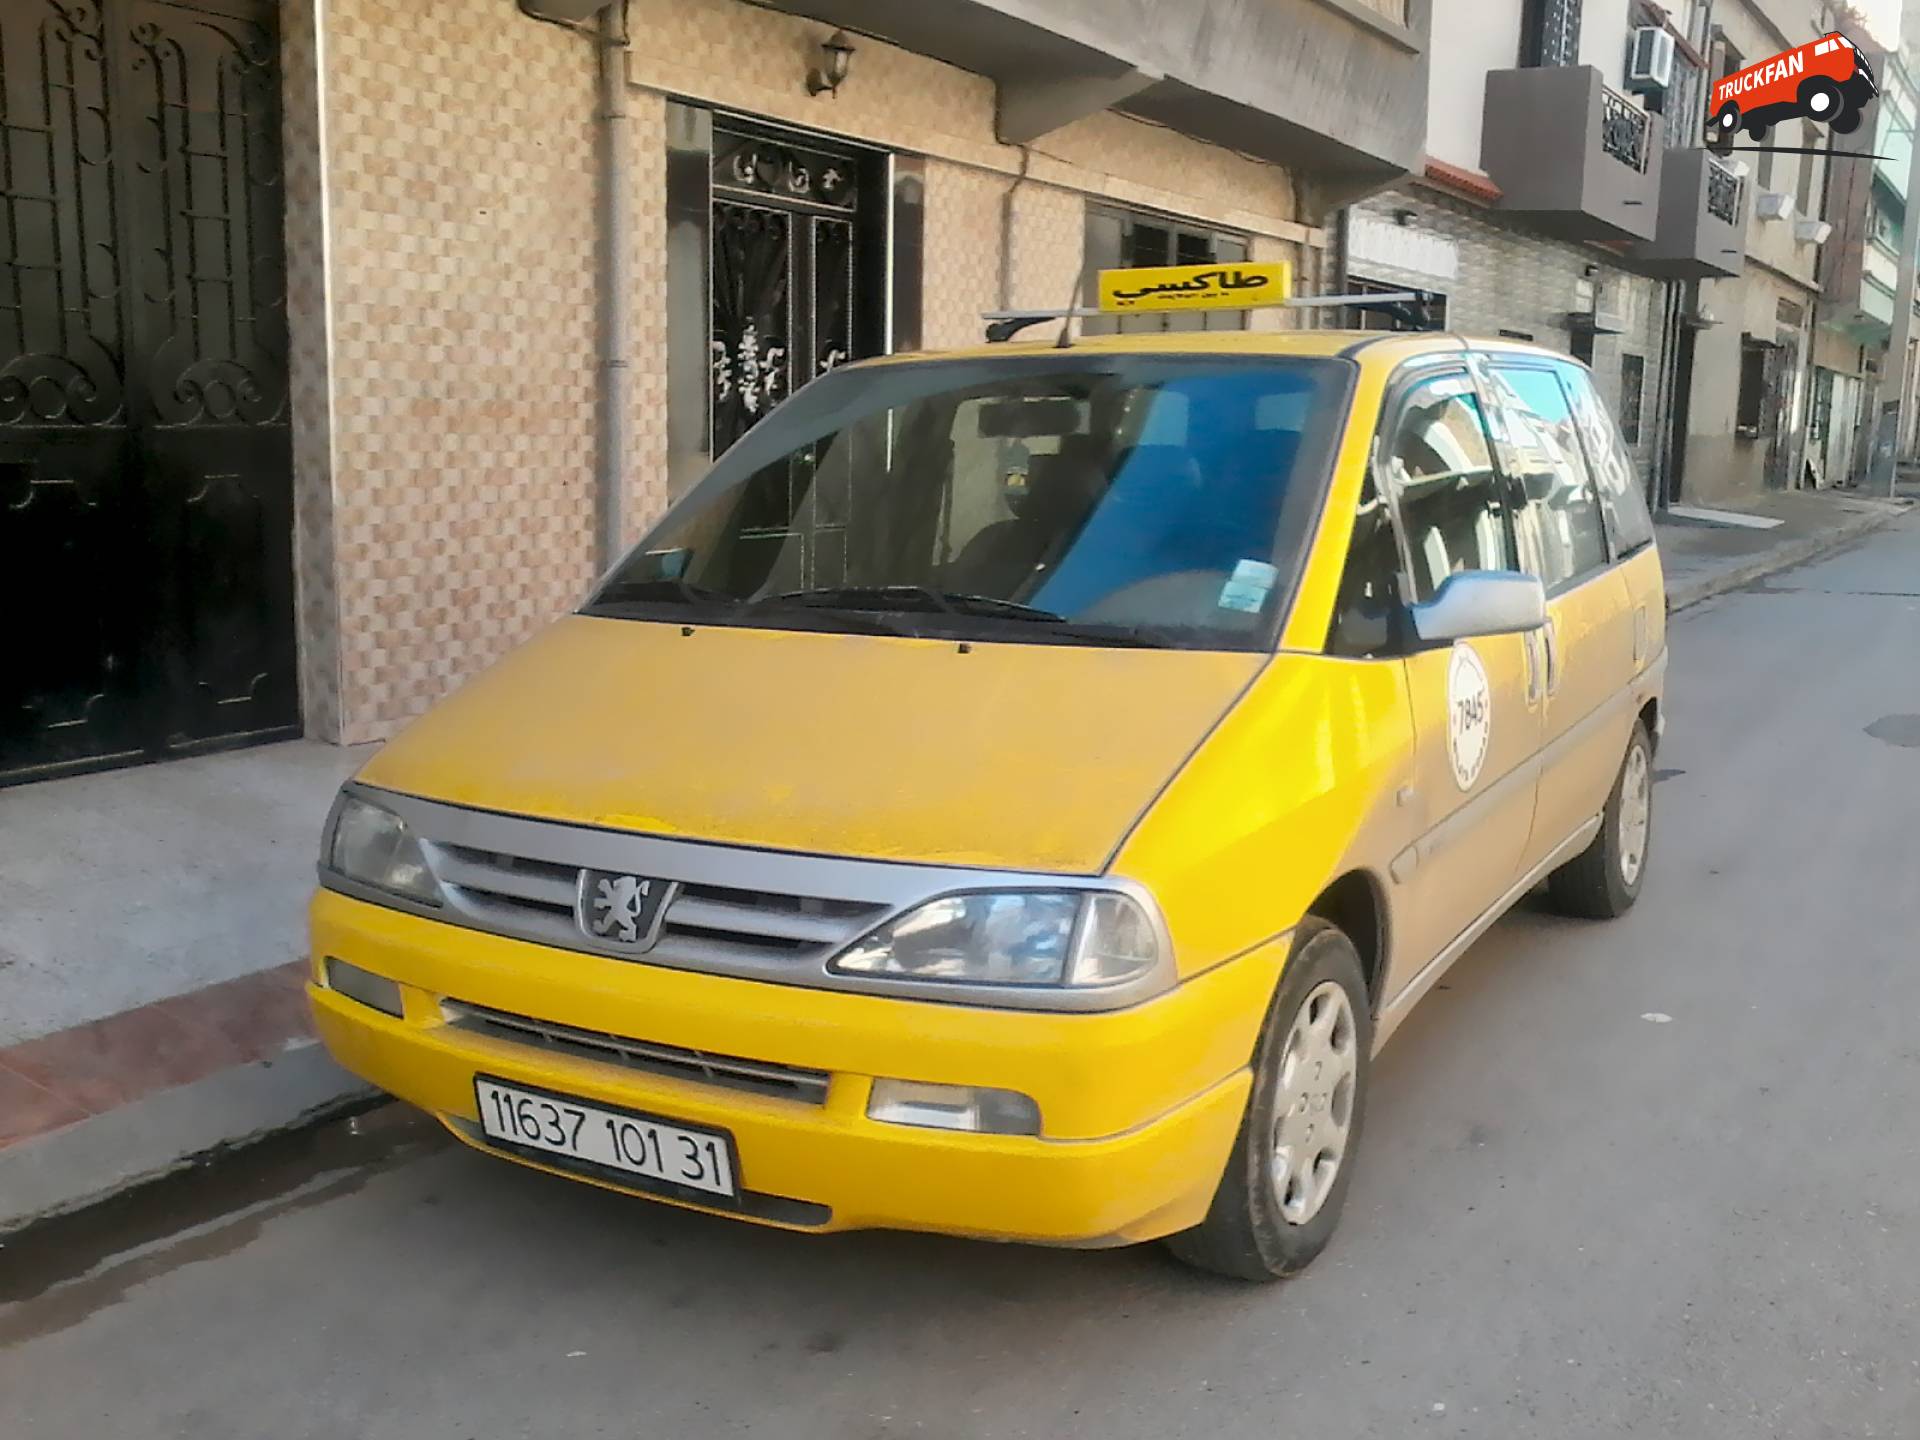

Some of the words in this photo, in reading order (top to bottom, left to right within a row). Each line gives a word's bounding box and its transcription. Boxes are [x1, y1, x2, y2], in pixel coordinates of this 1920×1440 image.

[1113, 271, 1268, 305] طاكسي
[1458, 690, 1484, 734] 7845
[491, 1091, 585, 1150] 11637
[606, 1119, 664, 1173] 101
[678, 1136, 721, 1187] 31
